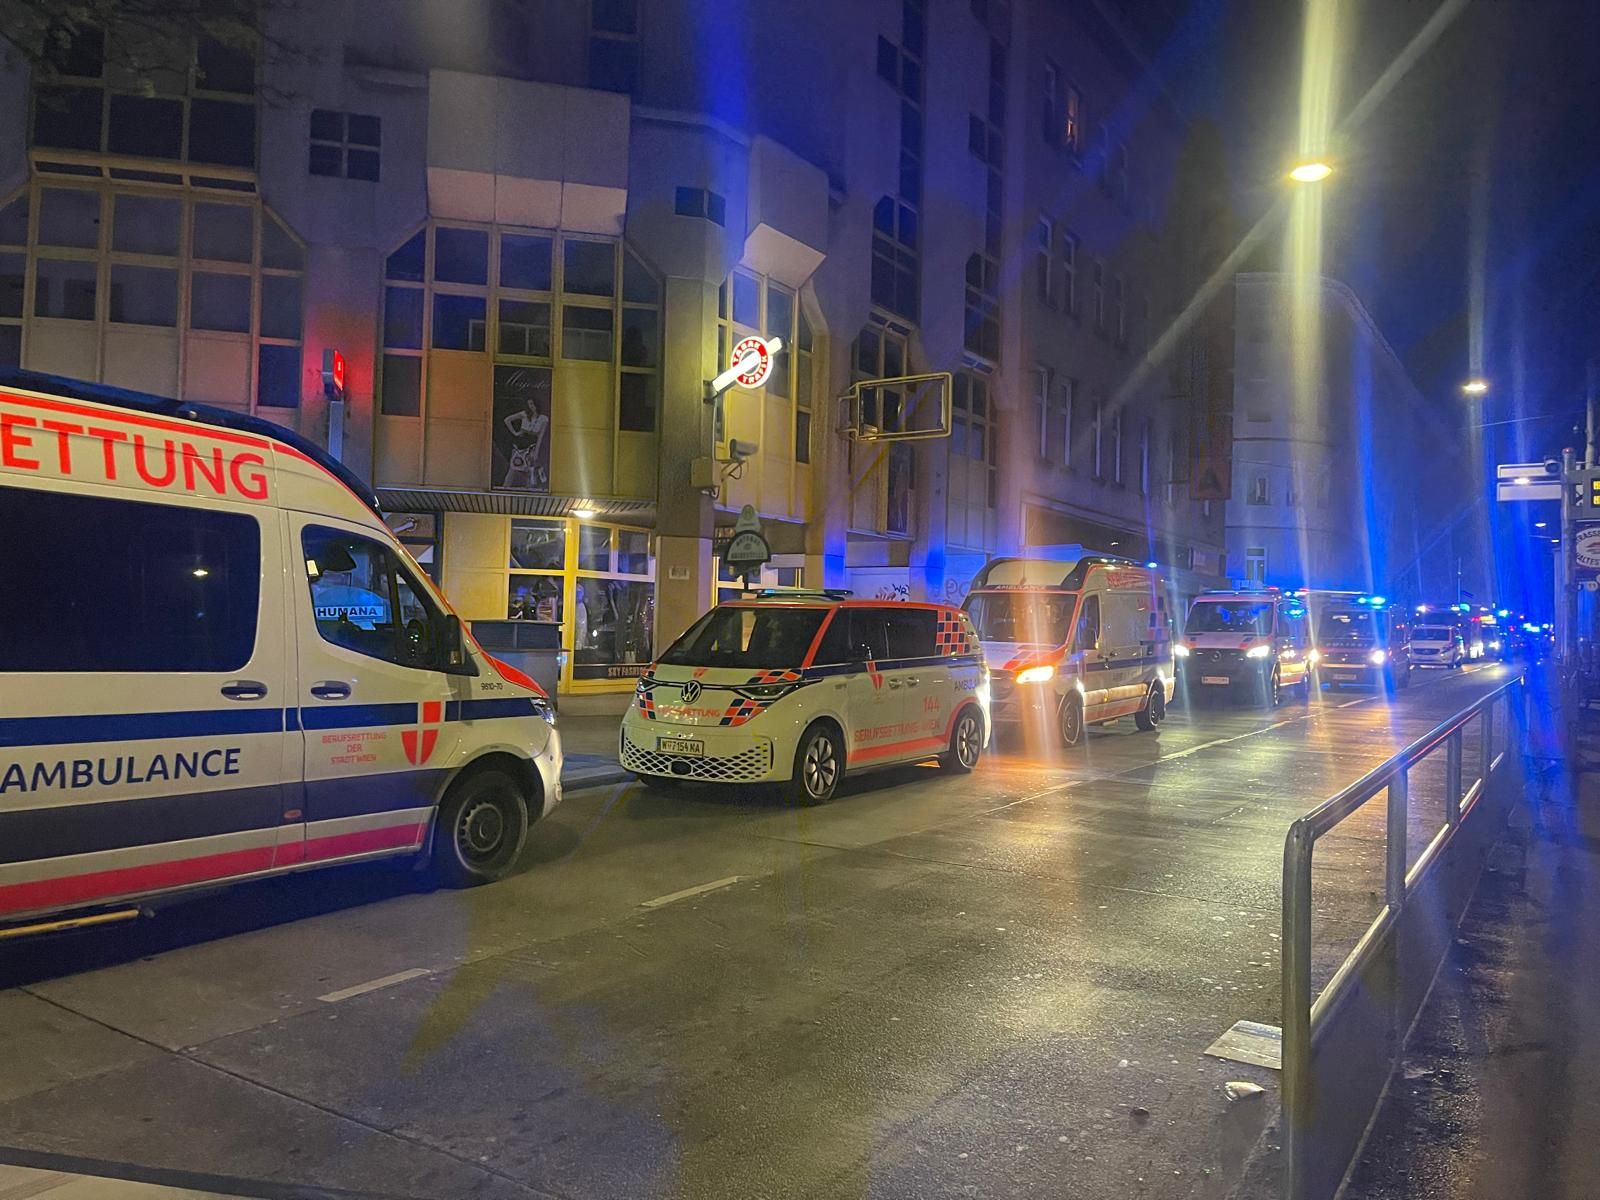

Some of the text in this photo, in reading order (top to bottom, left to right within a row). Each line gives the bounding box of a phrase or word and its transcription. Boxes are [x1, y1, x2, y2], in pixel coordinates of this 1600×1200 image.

[732, 340, 761, 363] TABAK
[742, 355, 768, 384] TRAFIK
[317, 607, 377, 617] HUMANA
[347, 744, 363, 753] DER
[0, 748, 241, 793] AMBULANCE
